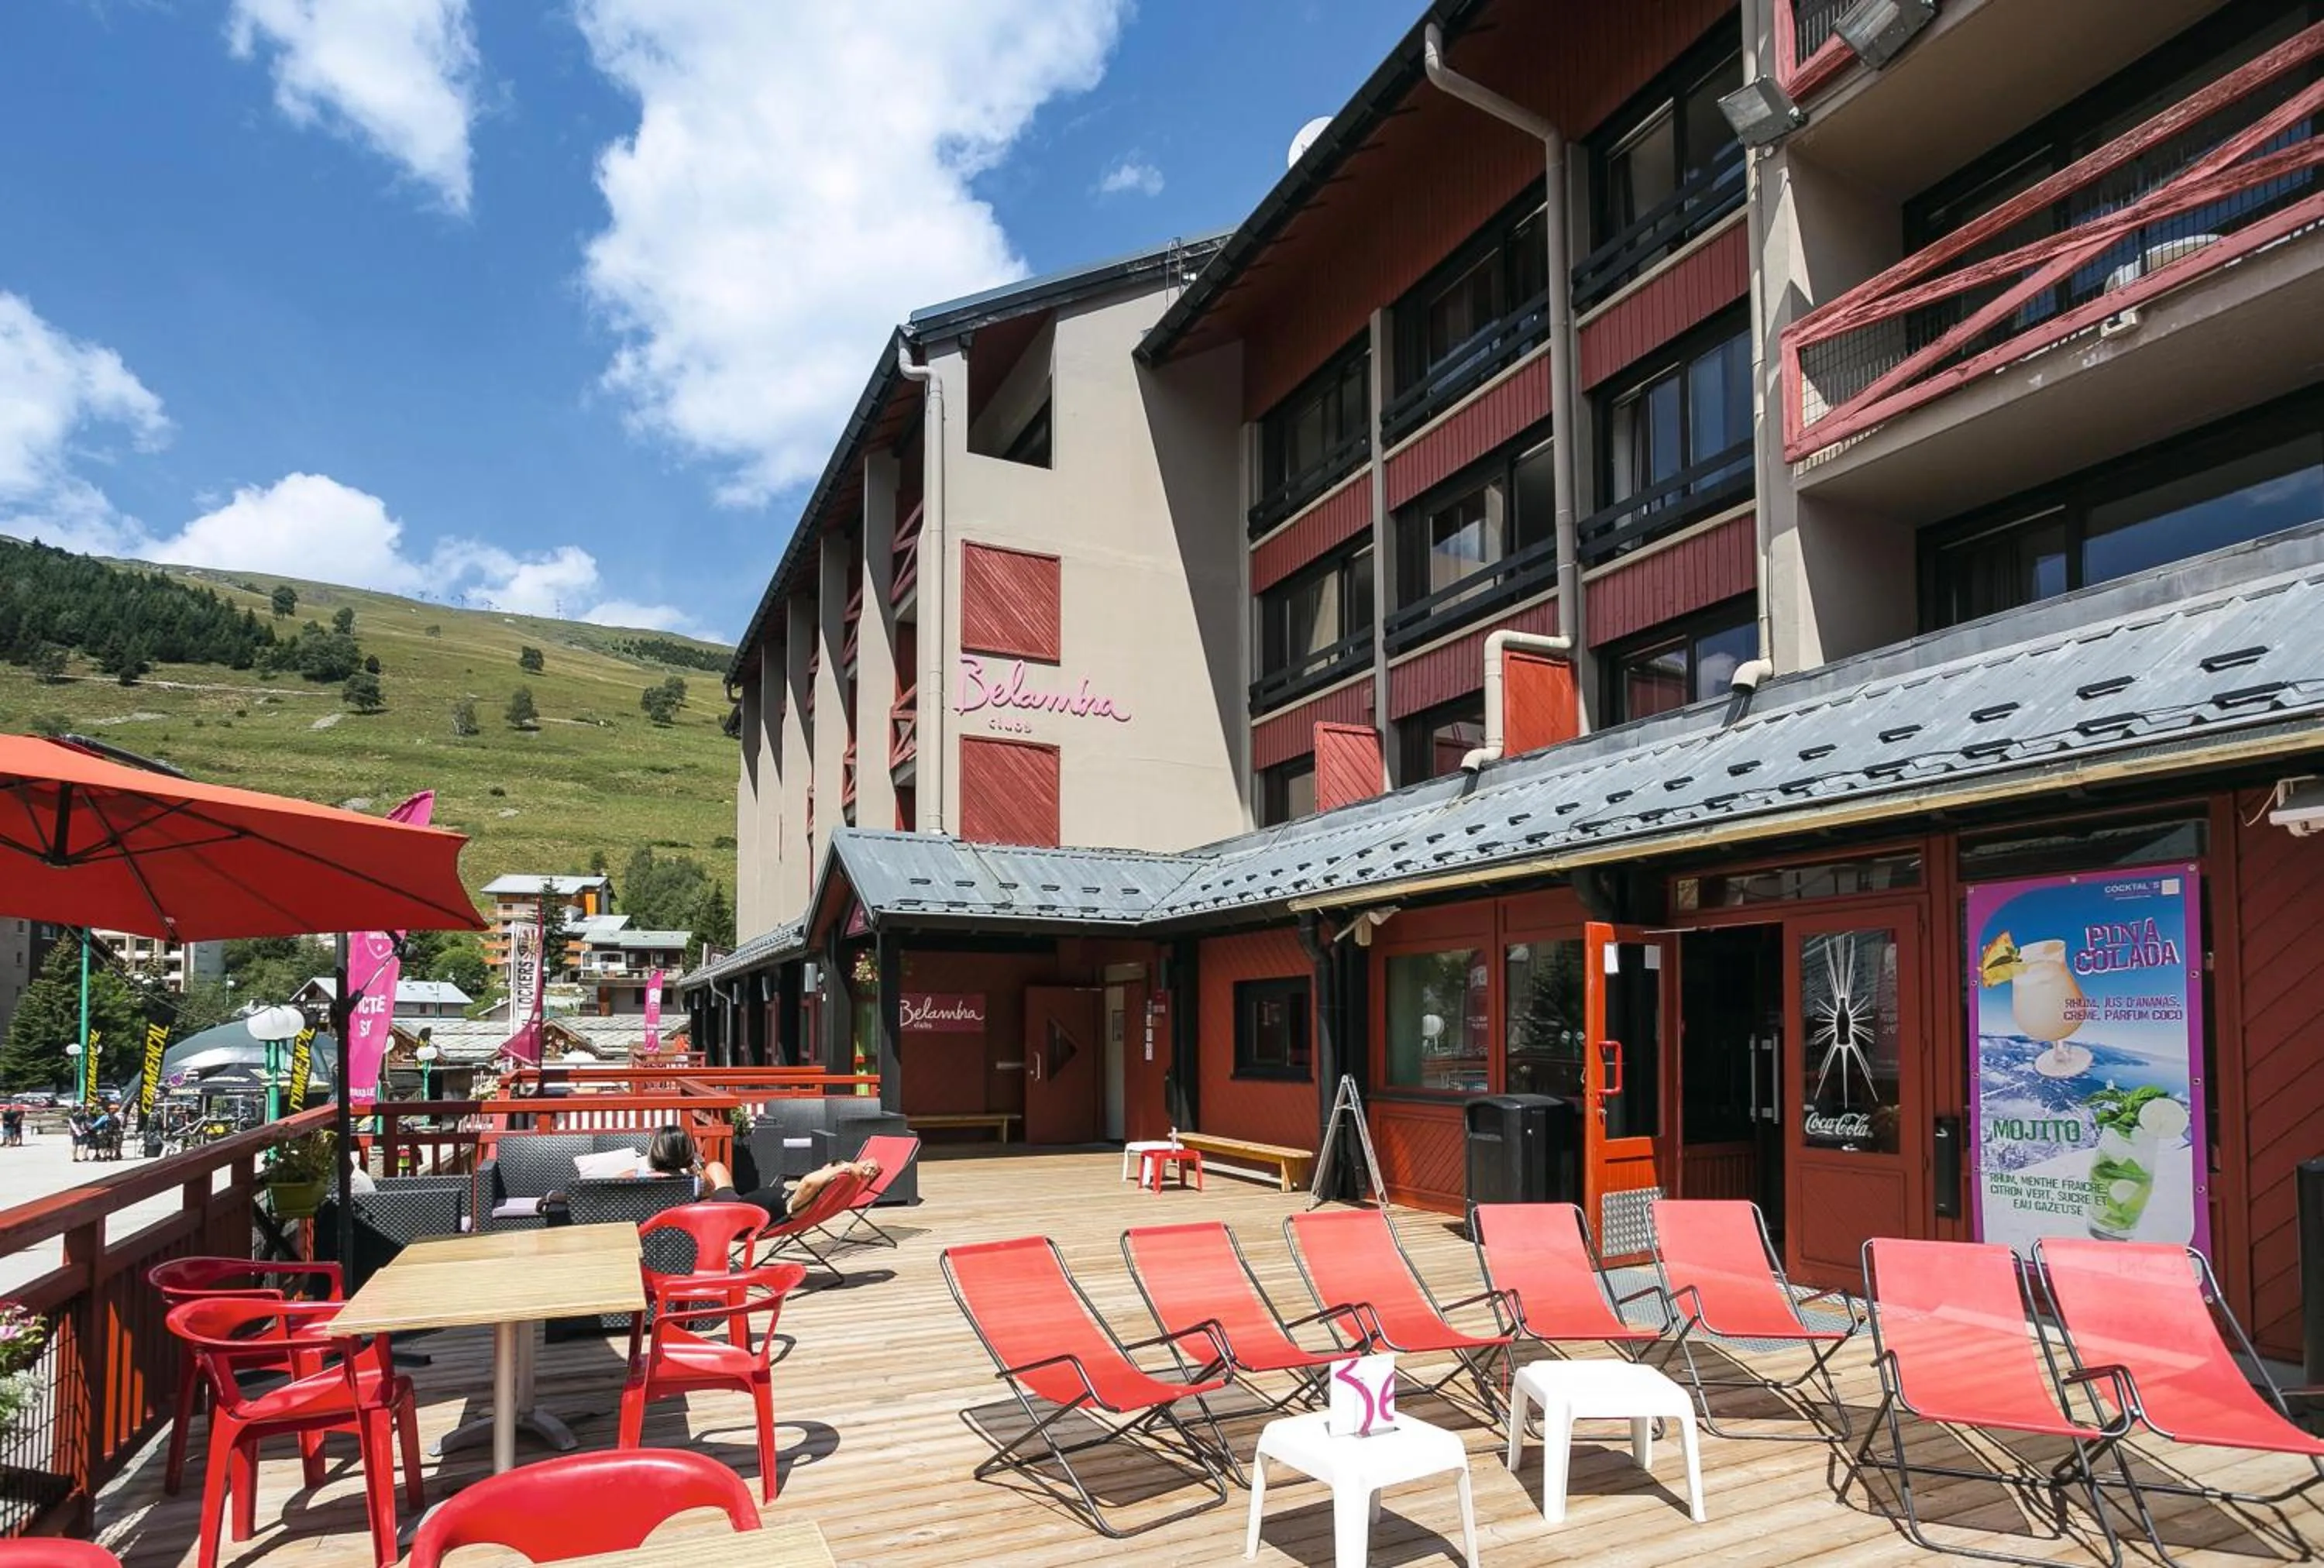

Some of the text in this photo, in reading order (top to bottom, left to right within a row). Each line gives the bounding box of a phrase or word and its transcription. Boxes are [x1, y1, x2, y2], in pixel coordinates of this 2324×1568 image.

[954, 654, 1131, 721] Belambra
[2074, 940, 2181, 975] COLADA
[899, 996, 985, 1027] Belambra
[2105, 996, 2123, 1008] JUS
[2104, 1009, 2150, 1020] PARFUM
[2152, 1009, 2183, 1020] COCO
[1805, 1112, 1871, 1137] Coca-Cola
[1992, 1119, 2082, 1143] MOJITO
[2021, 1176, 2058, 1189] MENTHE
[1990, 1185, 2023, 1197] CITRON
[2057, 1191, 2092, 1205] SUCRE
[2095, 1195, 2108, 1206] ET
[2013, 1198, 2084, 1216] EAU GAZEUSE
